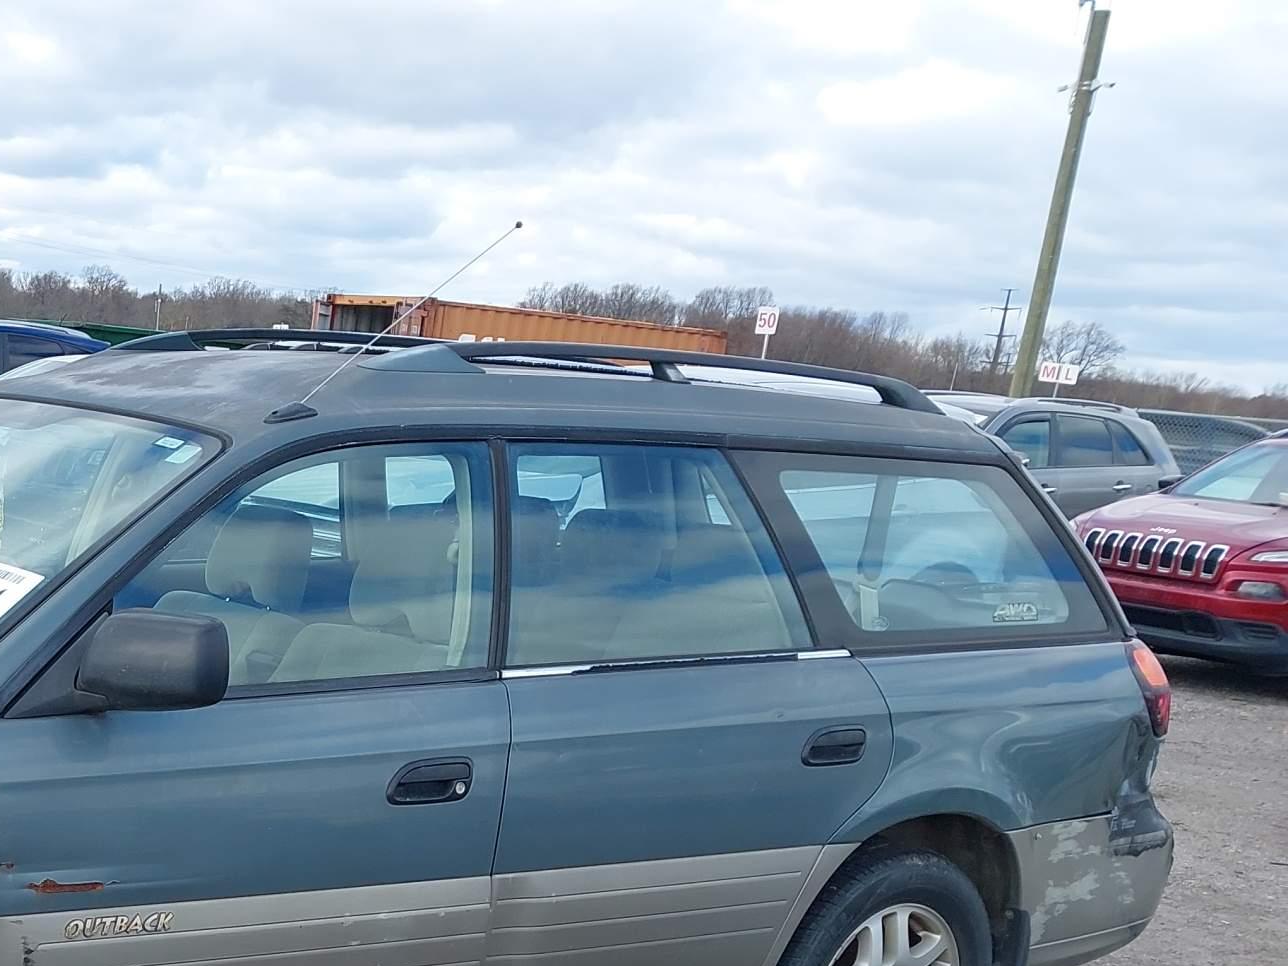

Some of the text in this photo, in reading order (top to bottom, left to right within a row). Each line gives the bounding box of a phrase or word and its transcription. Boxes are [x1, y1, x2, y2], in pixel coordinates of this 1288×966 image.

[758, 312, 777, 328] 50
[1042, 365, 1073, 380] M L
[1149, 526, 1177, 535] Jeep
[64, 911, 175, 939] OUTBACK
